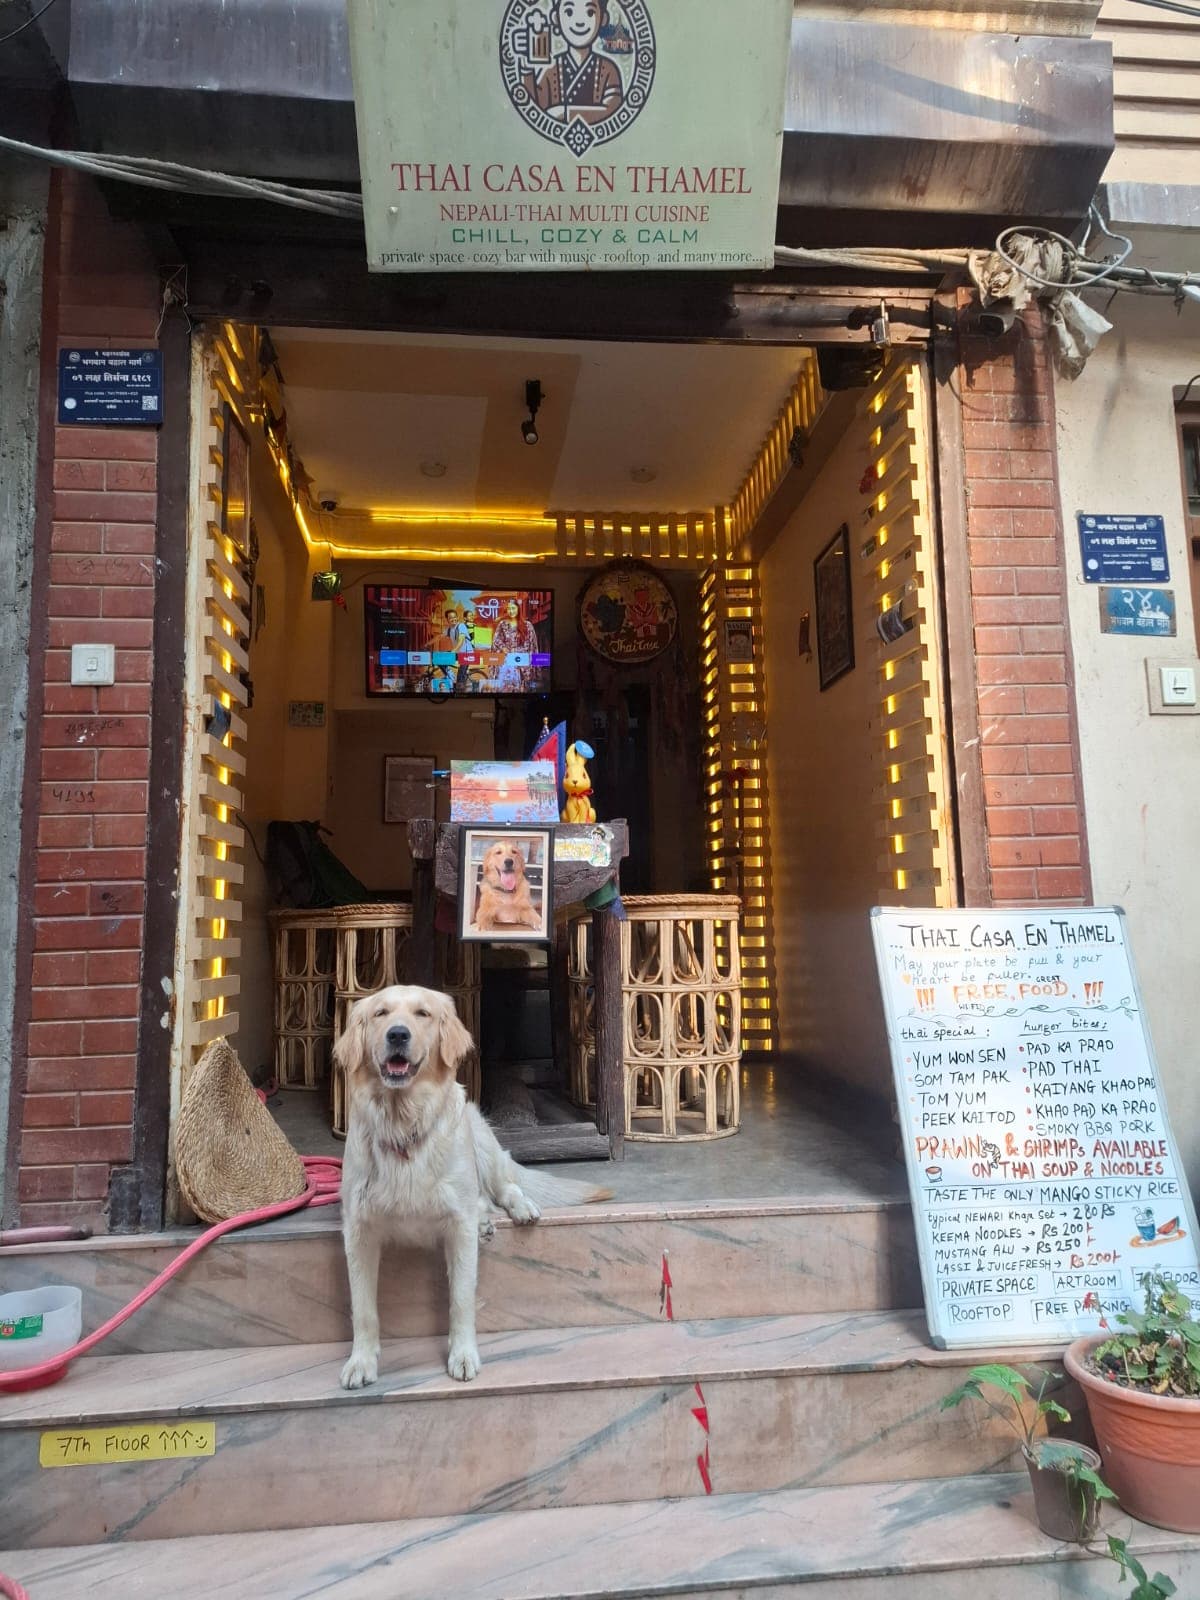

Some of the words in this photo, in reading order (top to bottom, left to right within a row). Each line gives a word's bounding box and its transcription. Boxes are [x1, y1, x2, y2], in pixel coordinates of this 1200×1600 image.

[391, 164, 471, 191] THAI
[483, 164, 564, 192] CASA
[576, 166, 616, 192] EN
[627, 167, 752, 193] THAMEL
[440, 205, 562, 221] NEPALI-THAI
[570, 205, 628, 221] MULTI
[635, 205, 709, 222] CUISINE
[453, 229, 528, 245] CHILL,
[541, 228, 603, 243] COZY
[613, 230, 626, 242] &
[638, 230, 698, 243] CALM
[381, 249, 425, 265] private
[430, 252, 465, 265] space
[473, 252, 499, 265] cozy
[505, 249, 525, 263] bar
[529, 250, 555, 263] with
[560, 249, 596, 263] music
[604, 249, 650, 265] rooftop
[658, 250, 679, 262] and
[684, 252, 716, 265] many
[971, 925, 1015, 947] CASA
[1025, 924, 1048, 946] EN
[1050, 920, 1114, 944] THAMEL
[894, 954, 922, 976] May
[933, 960, 959, 974] your
[1006, 956, 1017, 967] be
[1056, 954, 1064, 964] &
[1073, 955, 1102, 968] your
[912, 974, 950, 985] heart
[962, 973, 976, 982] be
[1027, 1042, 1050, 1055] PAD
[1058, 1042, 1071, 1053] KA
[913, 1051, 942, 1070] YUM
[978, 1047, 1005, 1062] SEN
[915, 1073, 942, 1087] SOM
[949, 1071, 974, 1085] TAM
[983, 1070, 1011, 1084] PAK
[1028, 1061, 1055, 1078] PAD
[1062, 1060, 1102, 1075] THAI
[917, 1092, 948, 1108] TOM
[955, 1092, 986, 1108] YUM
[1036, 1104, 1068, 1119] KHAO
[1074, 1103, 1096, 1118] PAD
[1102, 1103, 1118, 1116] KA
[1123, 1100, 1156, 1114] PRAO
[923, 1112, 956, 1128] PEEK
[1036, 1123, 1079, 1136] SMOKY
[1084, 1121, 1112, 1136] BBQ
[1120, 1120, 1155, 1134] PORK
[1005, 1132, 1019, 1156] &
[1093, 1139, 1168, 1159] AVAILABLE
[972, 1161, 991, 1178] ON
[999, 1161, 1035, 1179] THAI
[1042, 1161, 1078, 1177] SOUP
[1084, 1162, 1093, 1177] &
[1101, 1160, 1164, 1176] NOODLES
[924, 1188, 968, 1204] TASTE
[972, 1188, 996, 1199] THE
[1004, 1189, 1033, 1201] ONLY
[1040, 1186, 1090, 1205] MANGO
[1095, 1185, 1141, 1200] STICKY
[966, 1212, 1002, 1223] NEWARI
[1073, 1205, 1097, 1219] 280
[1102, 1204, 1115, 1219] Rs
[932, 1231, 969, 1244] KEEMA
[975, 1226, 1022, 1241] NOODLES
[1042, 1224, 1057, 1238] Rs
[935, 1246, 987, 1260] MUSTANG
[1037, 1242, 1051, 1255] Rs
[937, 1263, 971, 1275] LASSI
[1070, 1254, 1084, 1269] Rs
[942, 1280, 992, 1298] PRIVATE
[996, 1277, 1036, 1293] SPACE
[951, 1304, 1010, 1323] ROOFTOP
[1036, 1302, 1068, 1320] FREE
